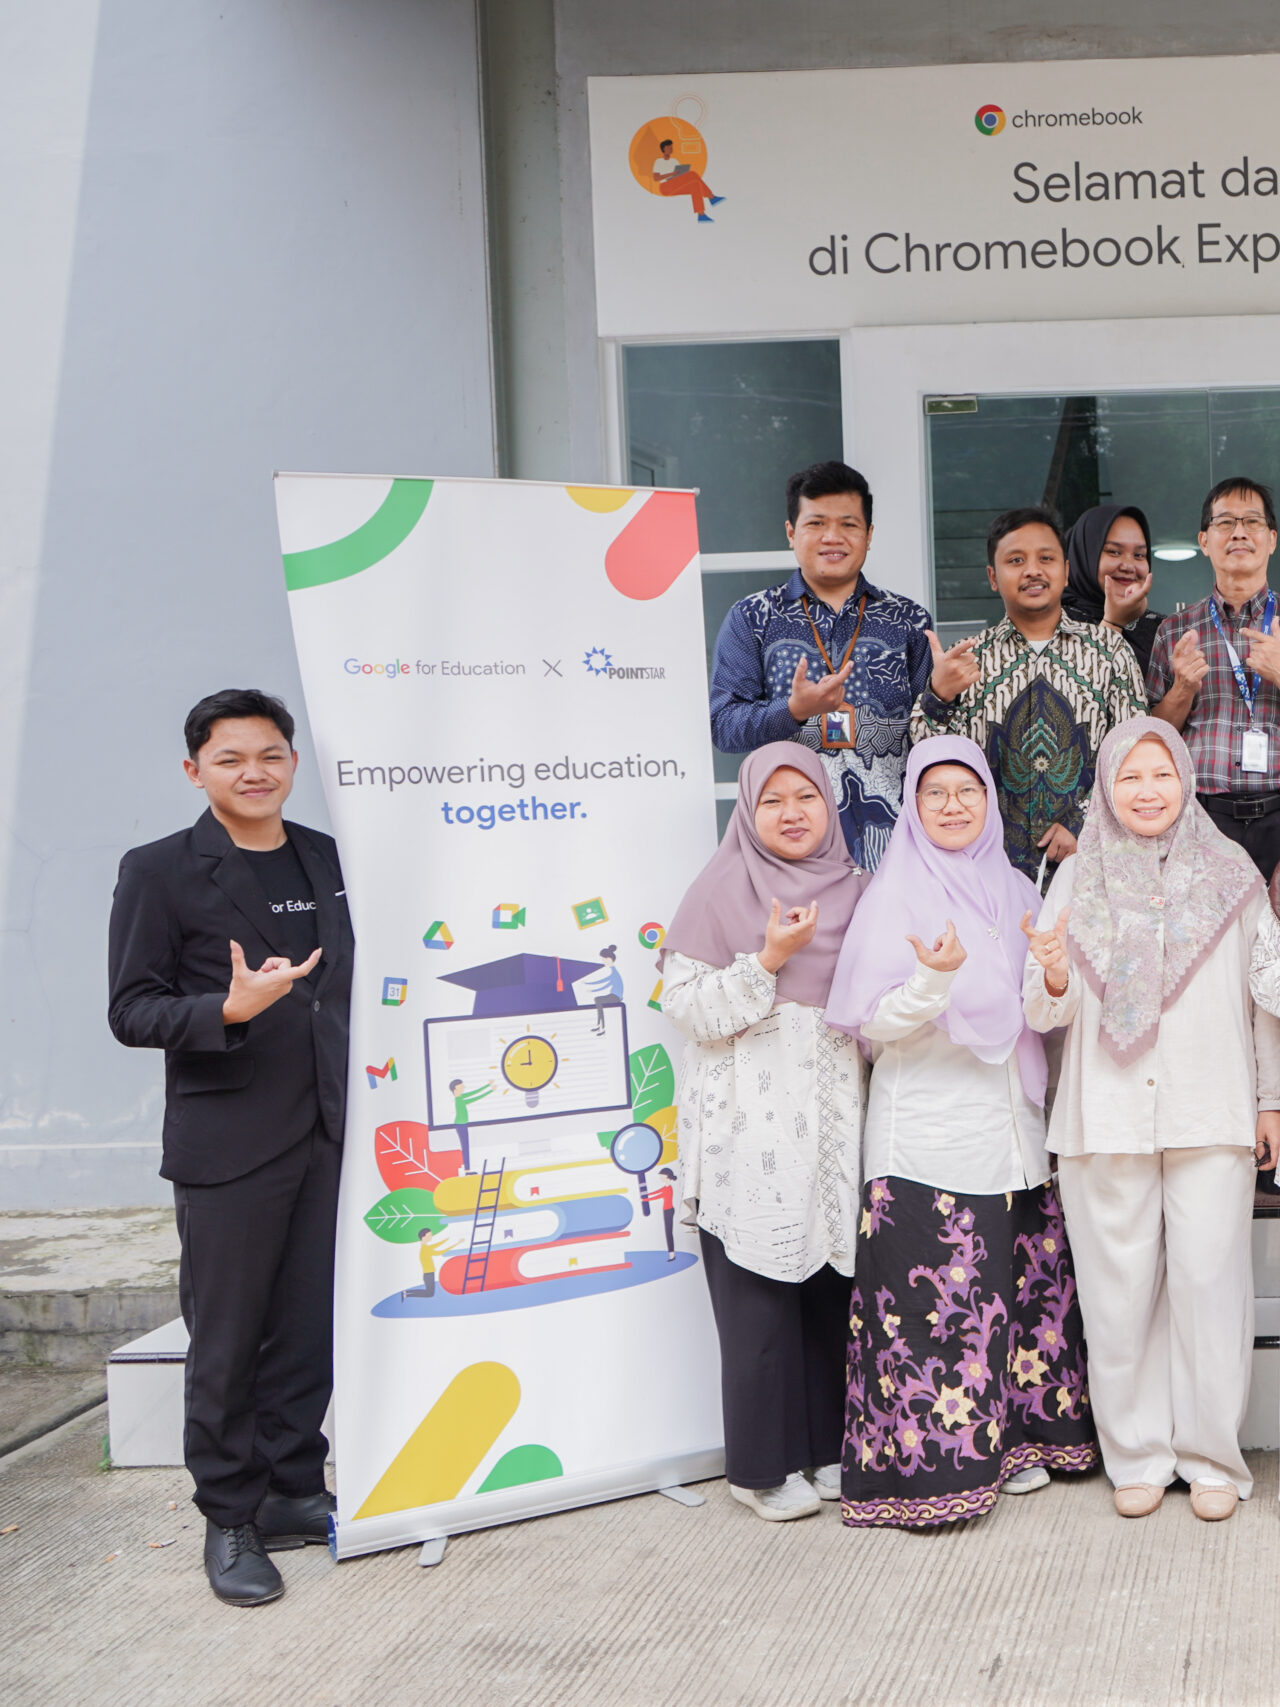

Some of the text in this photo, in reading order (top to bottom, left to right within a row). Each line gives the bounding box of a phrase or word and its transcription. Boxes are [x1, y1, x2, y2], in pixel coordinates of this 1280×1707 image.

[1012, 106, 1142, 128] chromebook
[1013, 161, 1205, 203] Selamat
[809, 234, 848, 275] di
[865, 225, 1182, 273] Chromebook
[344, 658, 525, 678] Google for Education
[608, 665, 666, 680] POINTSTAR
[337, 754, 685, 792] Empowering education,
[441, 796, 587, 830] together.
[269, 900, 316, 913] or Educ
[389, 986, 400, 997] 31
